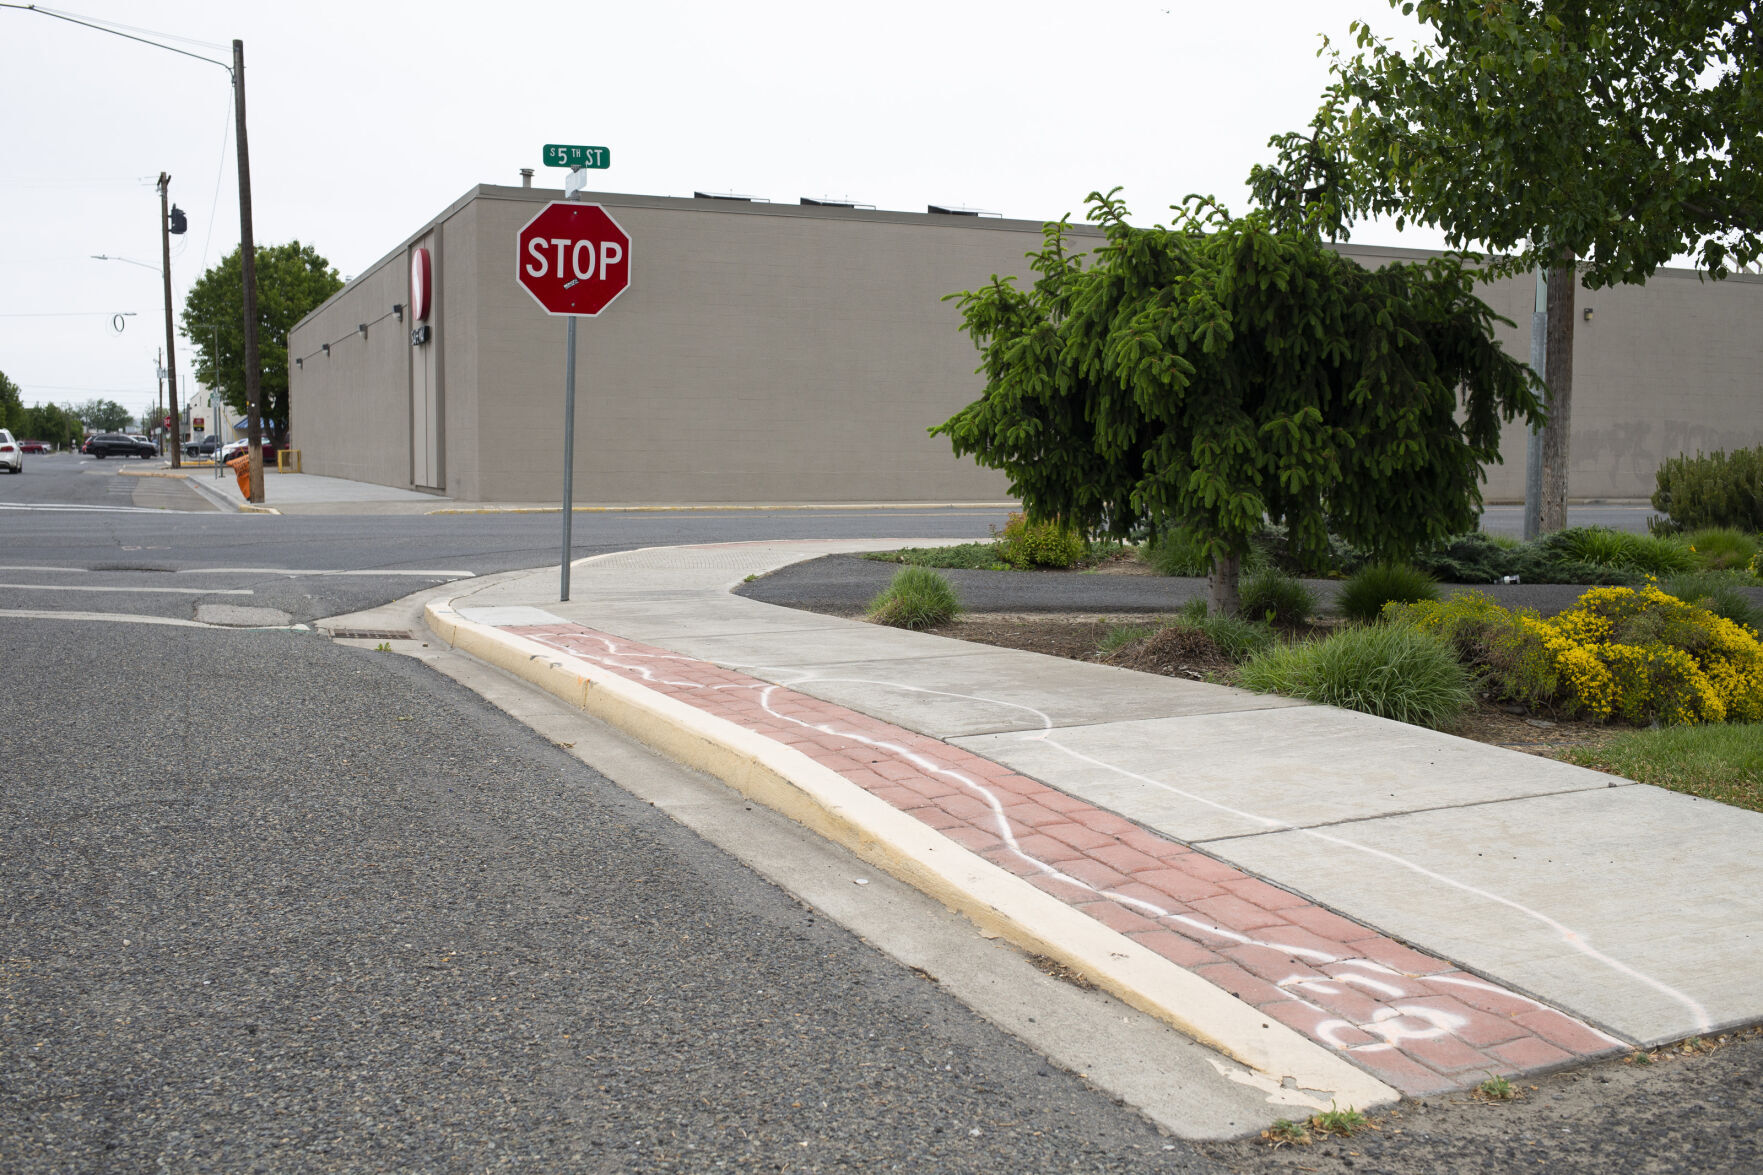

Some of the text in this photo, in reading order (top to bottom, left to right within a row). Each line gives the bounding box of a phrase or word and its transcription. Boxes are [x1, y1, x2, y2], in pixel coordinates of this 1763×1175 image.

[550, 148, 555, 157] S
[585, 149, 603, 166] ST
[526, 237, 623, 280] STOP
